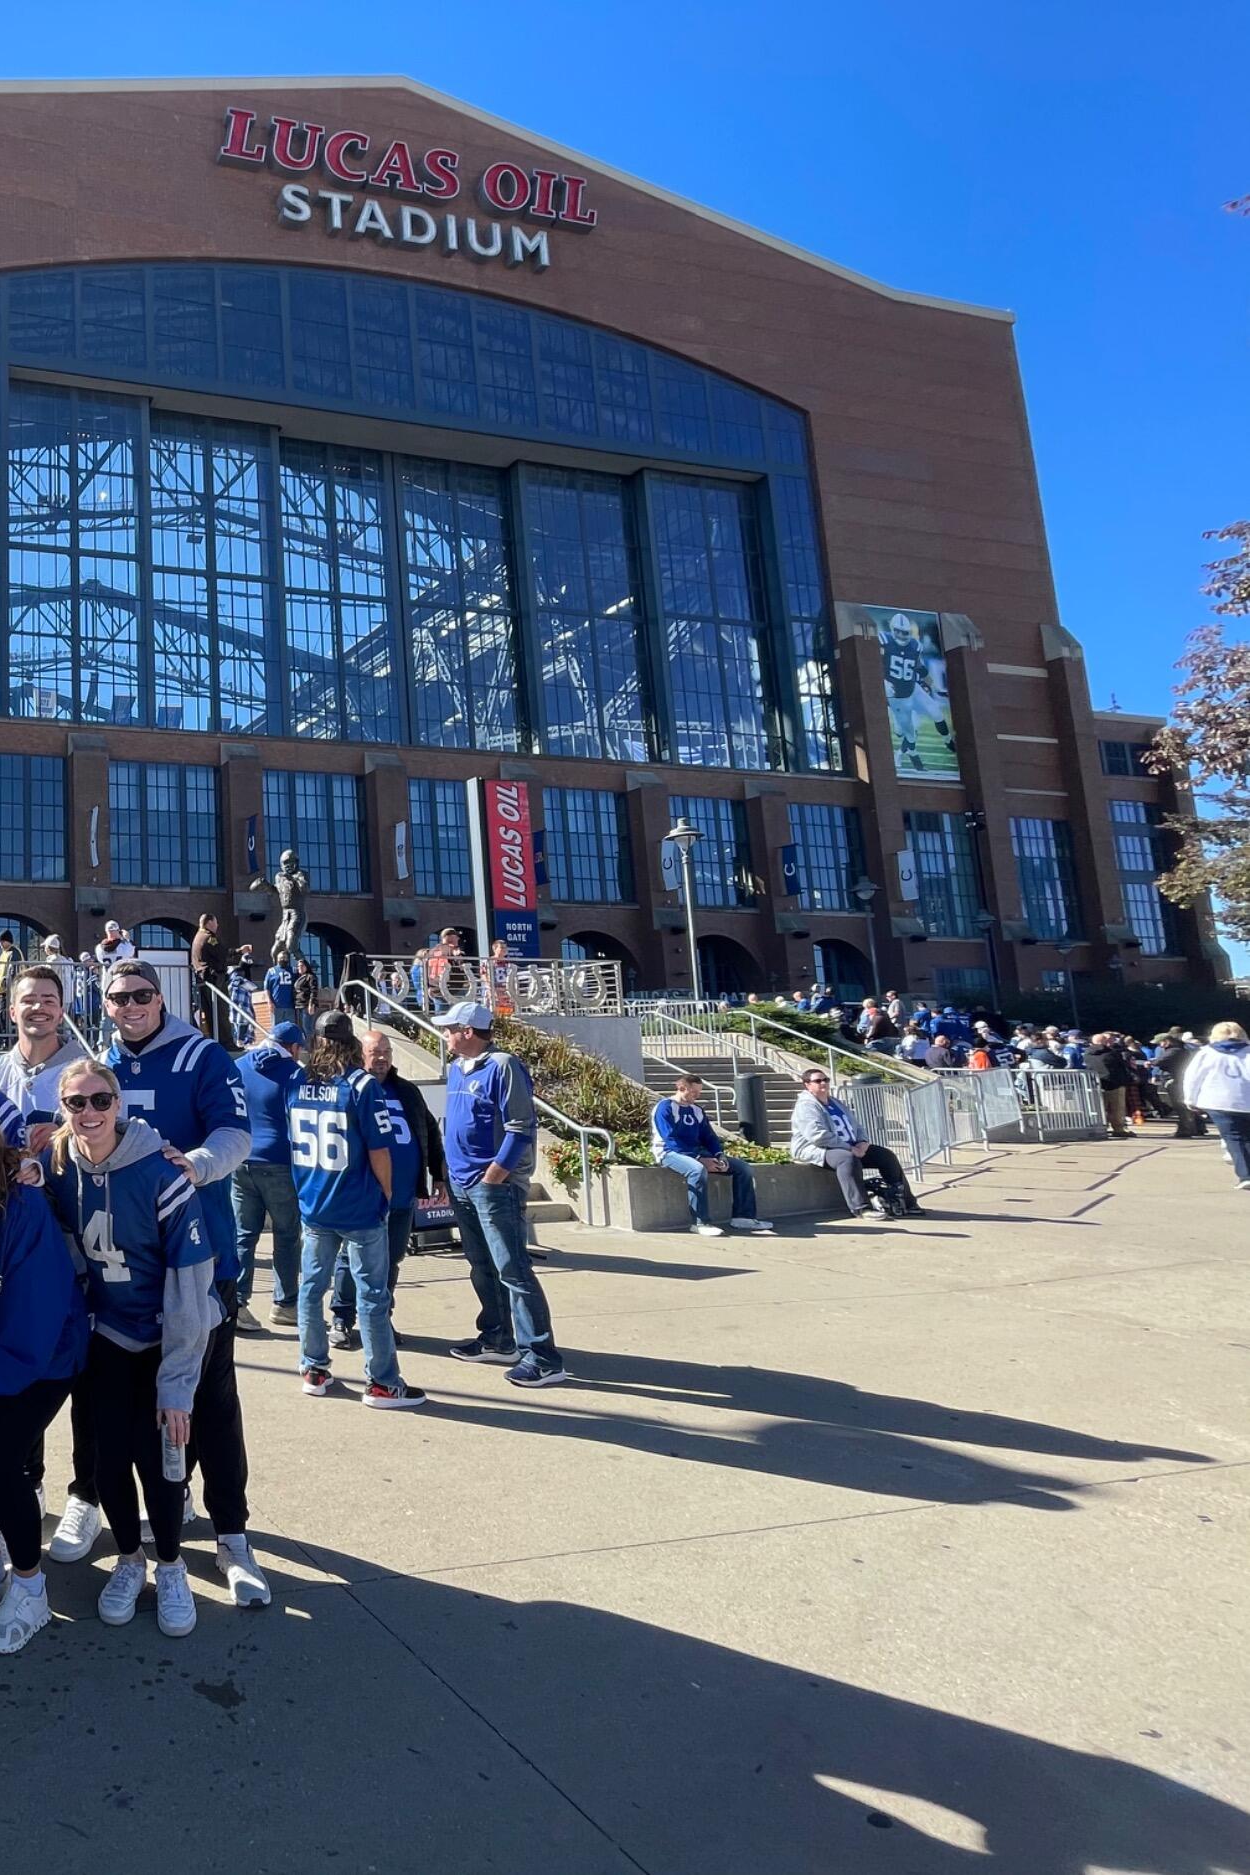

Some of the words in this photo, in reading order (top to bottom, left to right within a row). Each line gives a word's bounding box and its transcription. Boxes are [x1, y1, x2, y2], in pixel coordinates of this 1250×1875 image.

[219, 106, 460, 199] LUCAS
[482, 161, 598, 228] OIL
[279, 183, 550, 268] STADIUM
[890, 655, 915, 681] 56
[496, 784, 522, 823] OIL
[500, 826, 527, 909] LUCAS
[505, 922, 533, 931] NORTH
[506, 933, 527, 942] GATE
[278, 971, 292, 985] 12
[230, 1087, 248, 1118] 5
[298, 1084, 339, 1103] NELSON
[290, 1107, 349, 1172] 56
[82, 1209, 132, 1283] 4
[189, 1226, 201, 1245] 4
